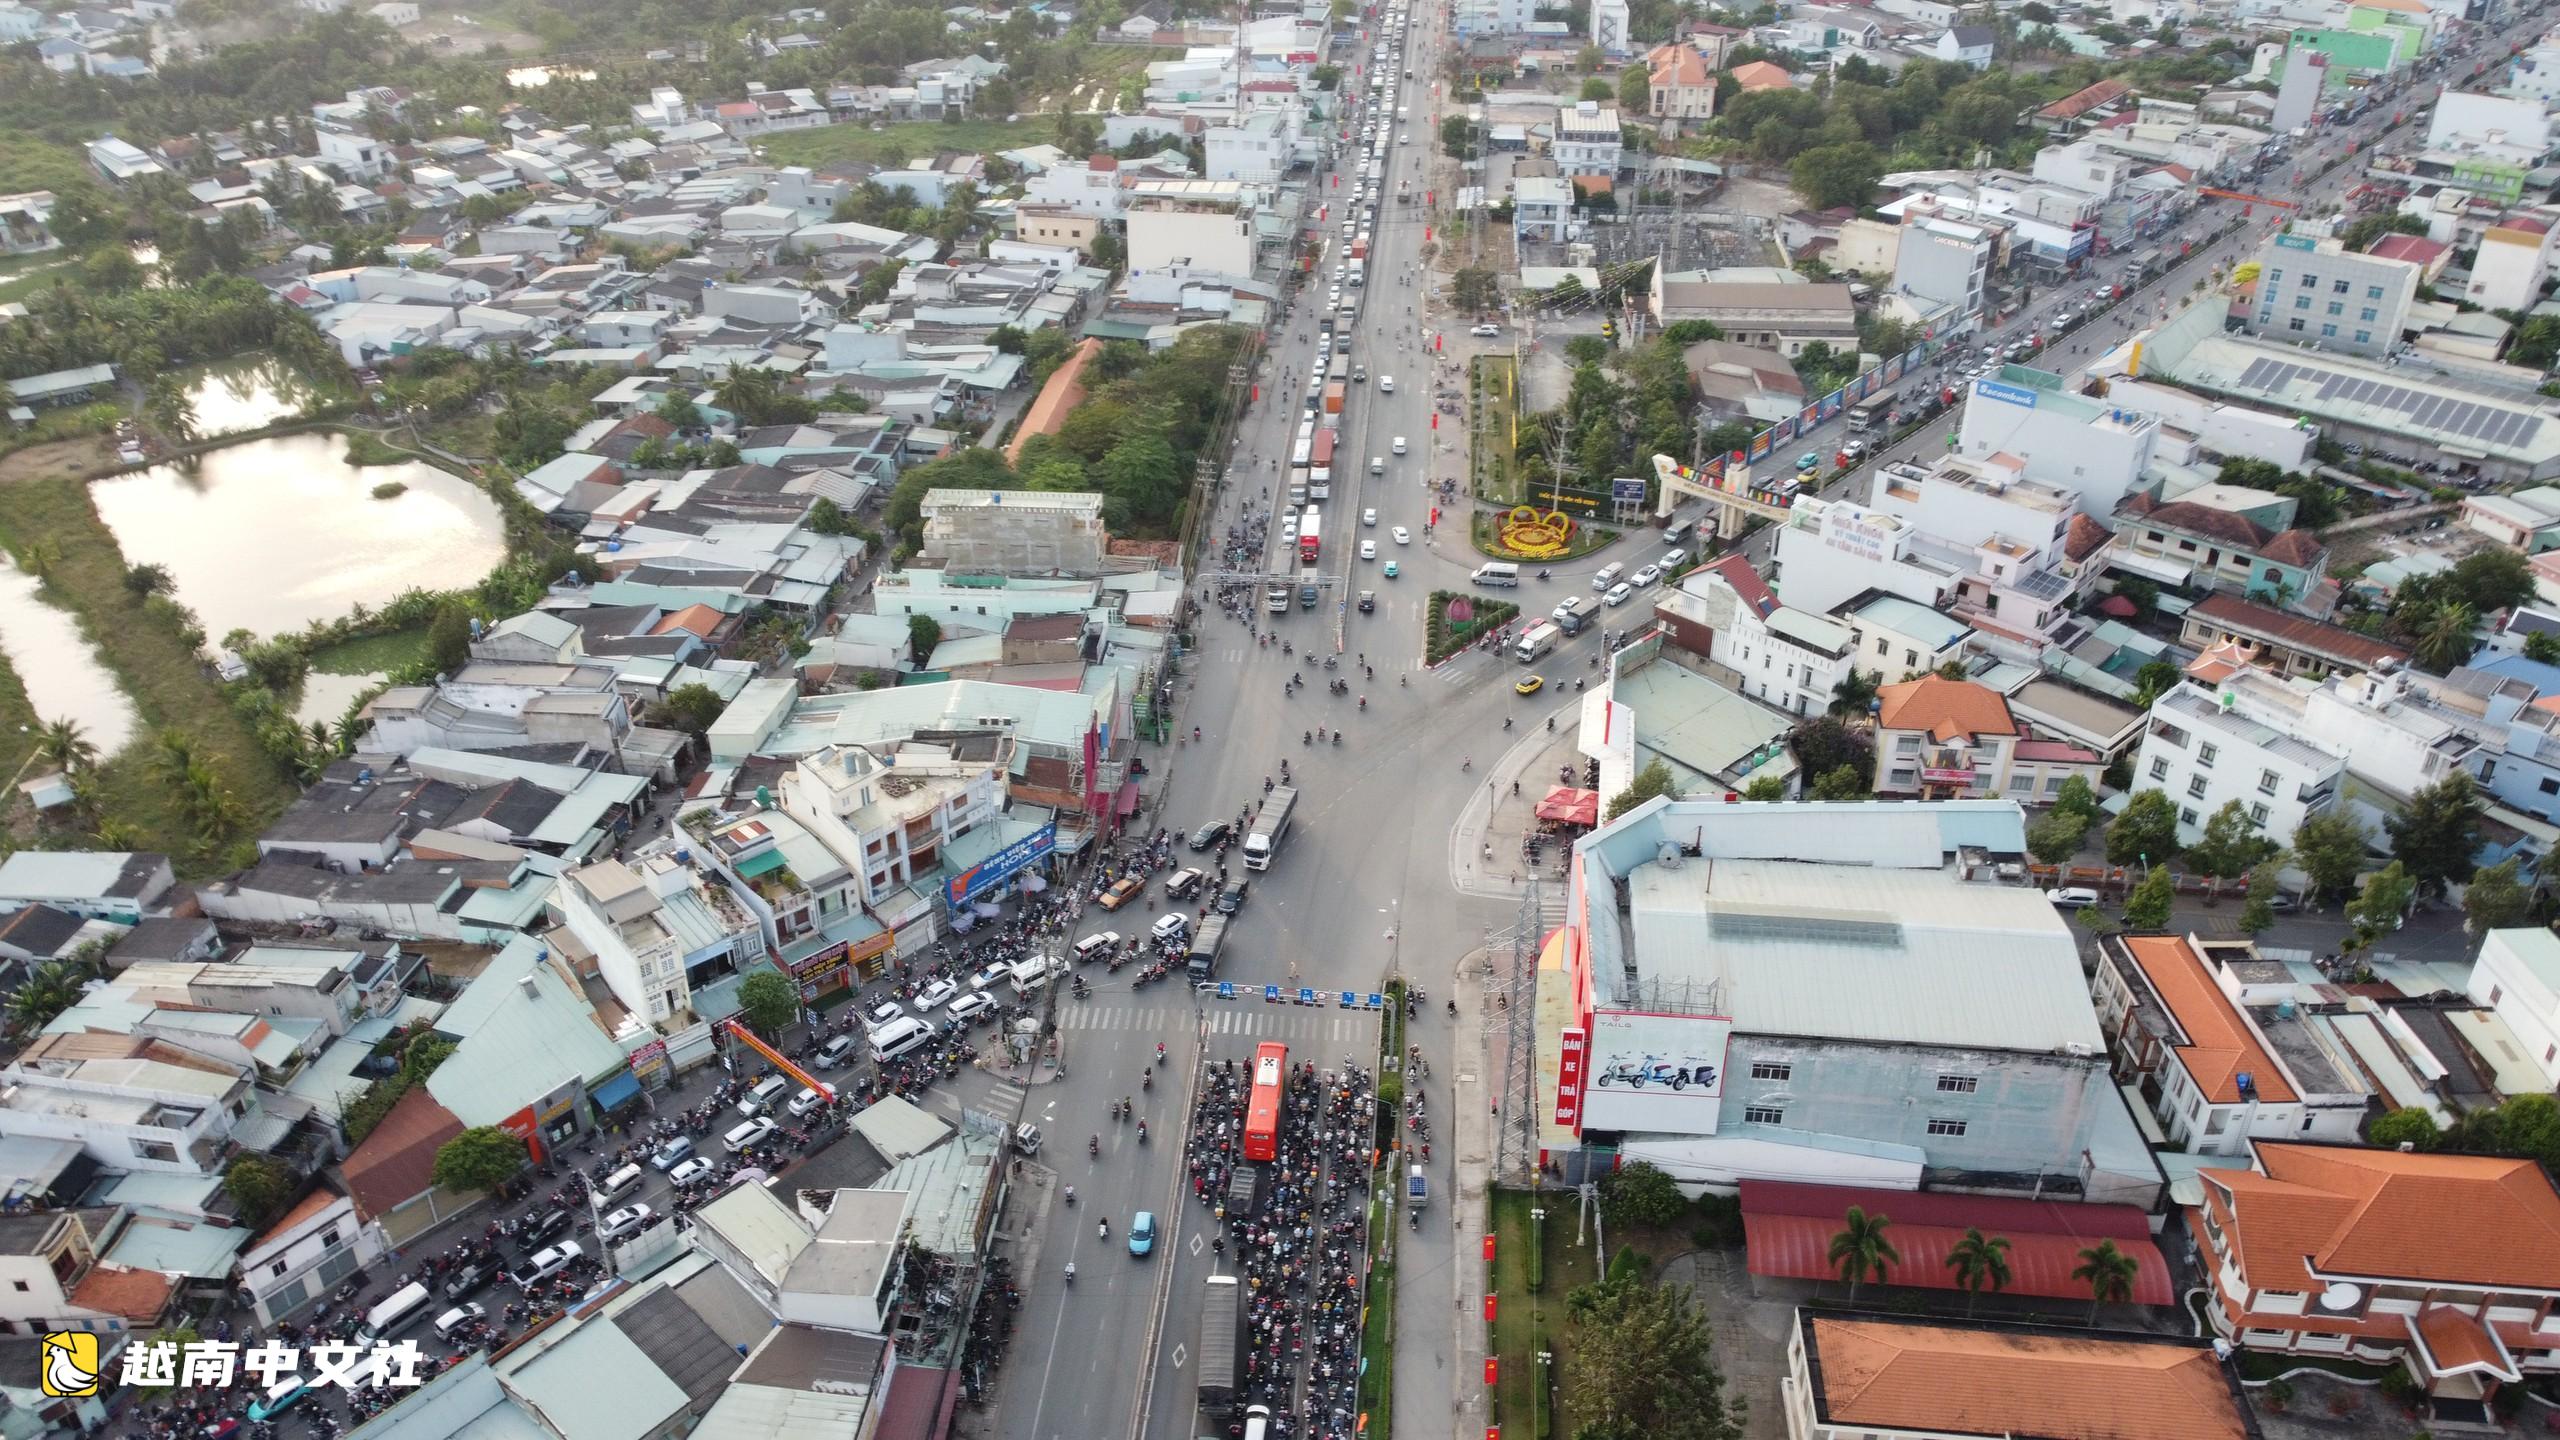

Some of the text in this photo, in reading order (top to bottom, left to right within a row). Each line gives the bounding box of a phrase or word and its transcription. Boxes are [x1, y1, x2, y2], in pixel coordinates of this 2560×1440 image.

[1978, 383, 2033, 406] Sacombank
[1563, 1039, 1581, 1051] BÁN
[1565, 1061, 1576, 1072] XE
[1560, 1084, 1575, 1097] TRẢ
[1557, 1107, 1574, 1119] GÓP
